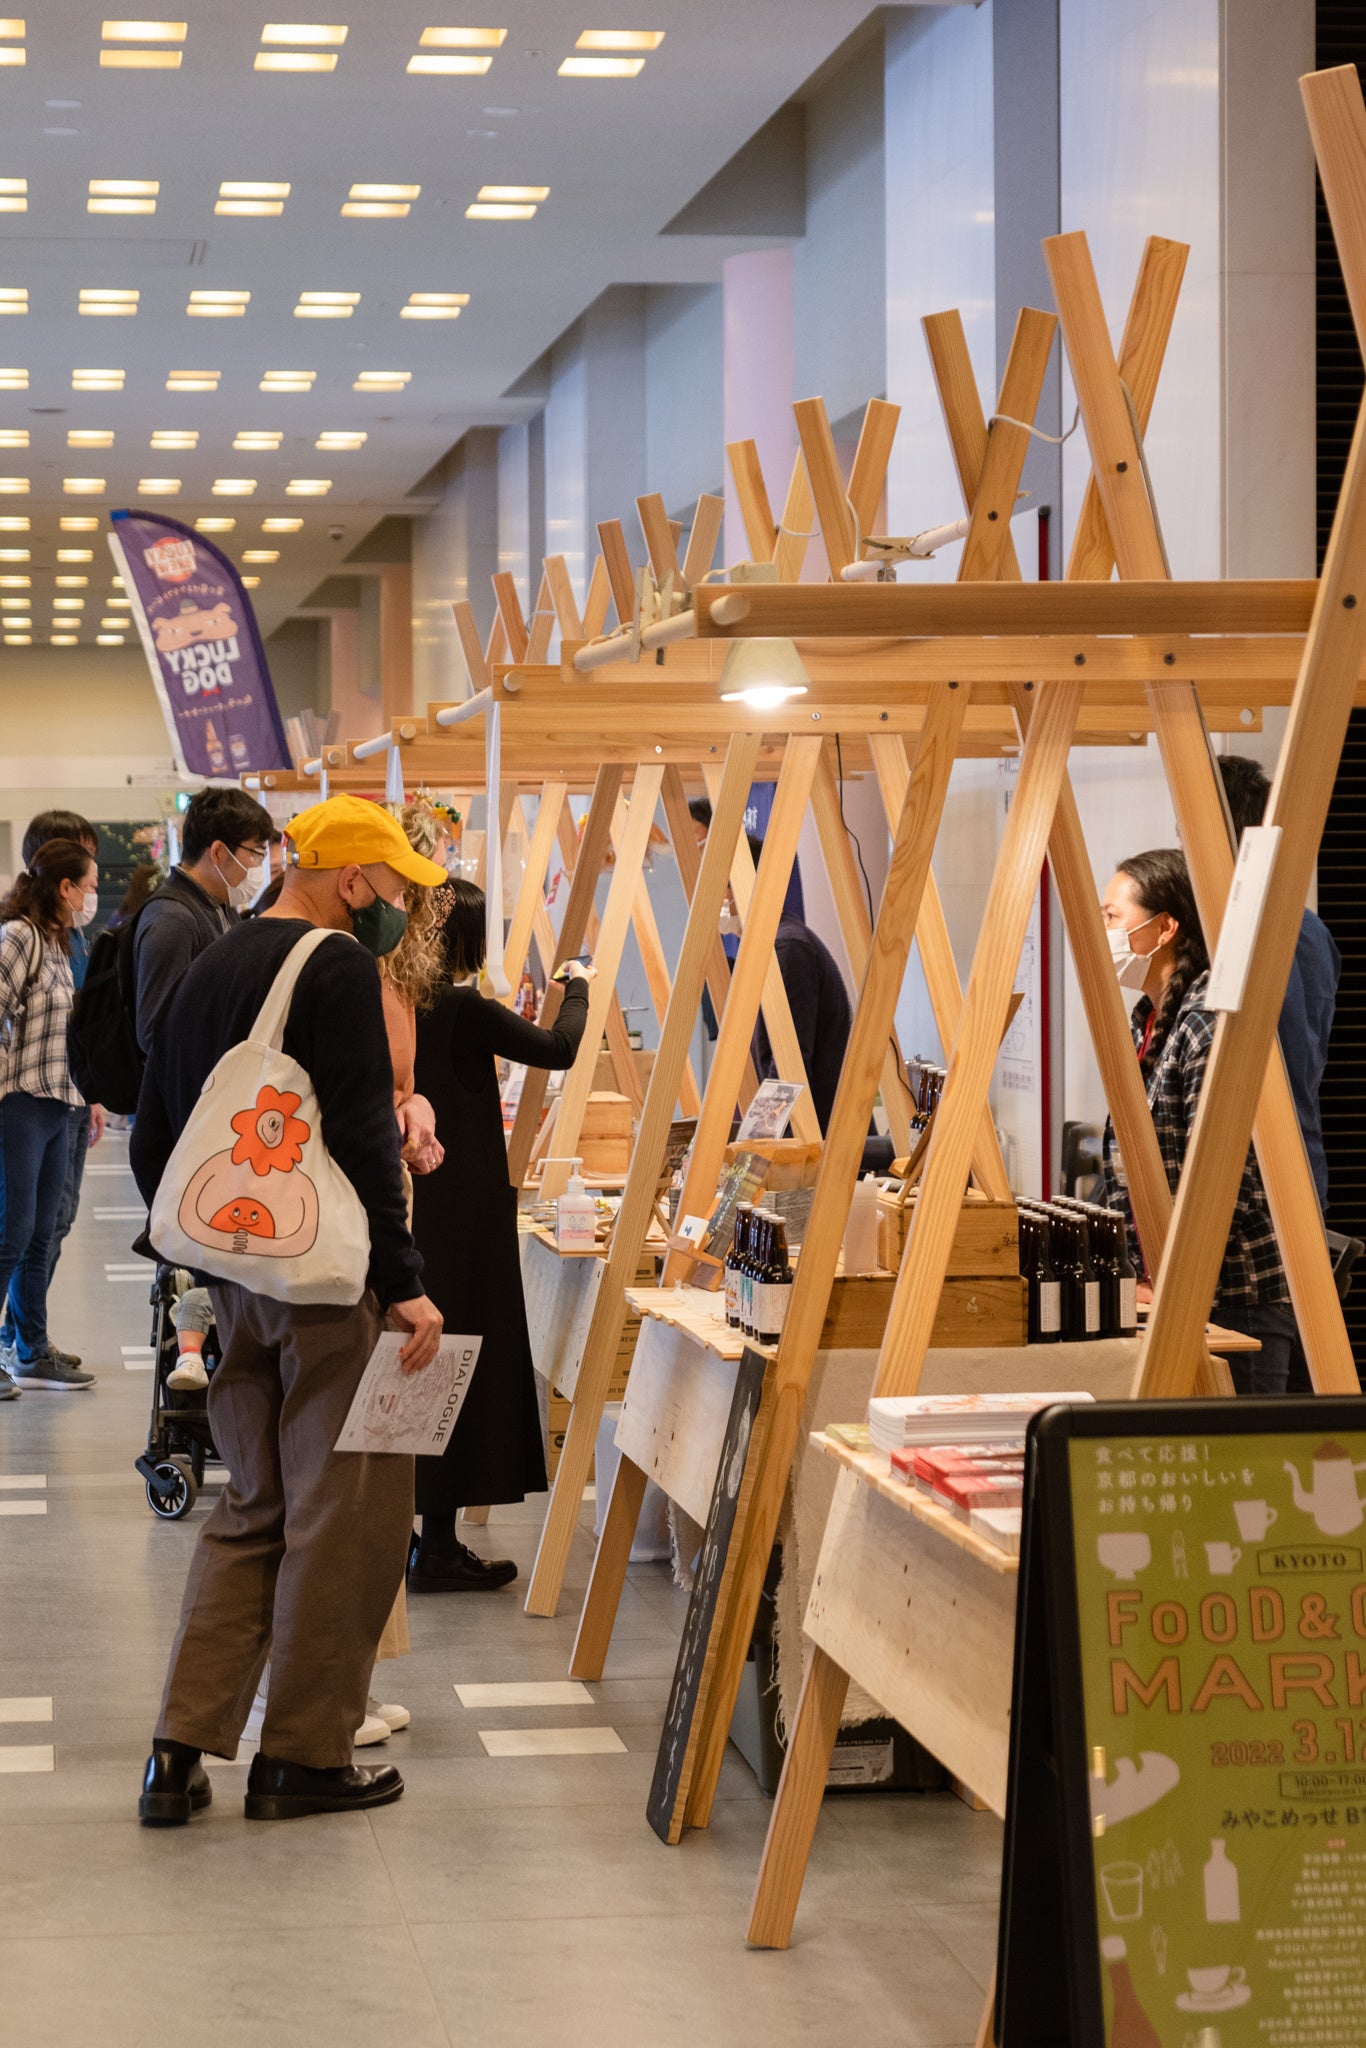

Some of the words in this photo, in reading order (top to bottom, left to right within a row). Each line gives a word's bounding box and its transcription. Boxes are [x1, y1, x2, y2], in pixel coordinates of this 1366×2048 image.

[432, 1349, 473, 1442] DIALOGUE
[1097, 1467, 1255, 1489] 京都のおいしいを
[1098, 1493, 1193, 1514] お持ち帰り
[1274, 1553, 1347, 1569] KYOTO
[1210, 1740, 1285, 1767] 2022
[1221, 1806, 1337, 1829] みやこめっせ
